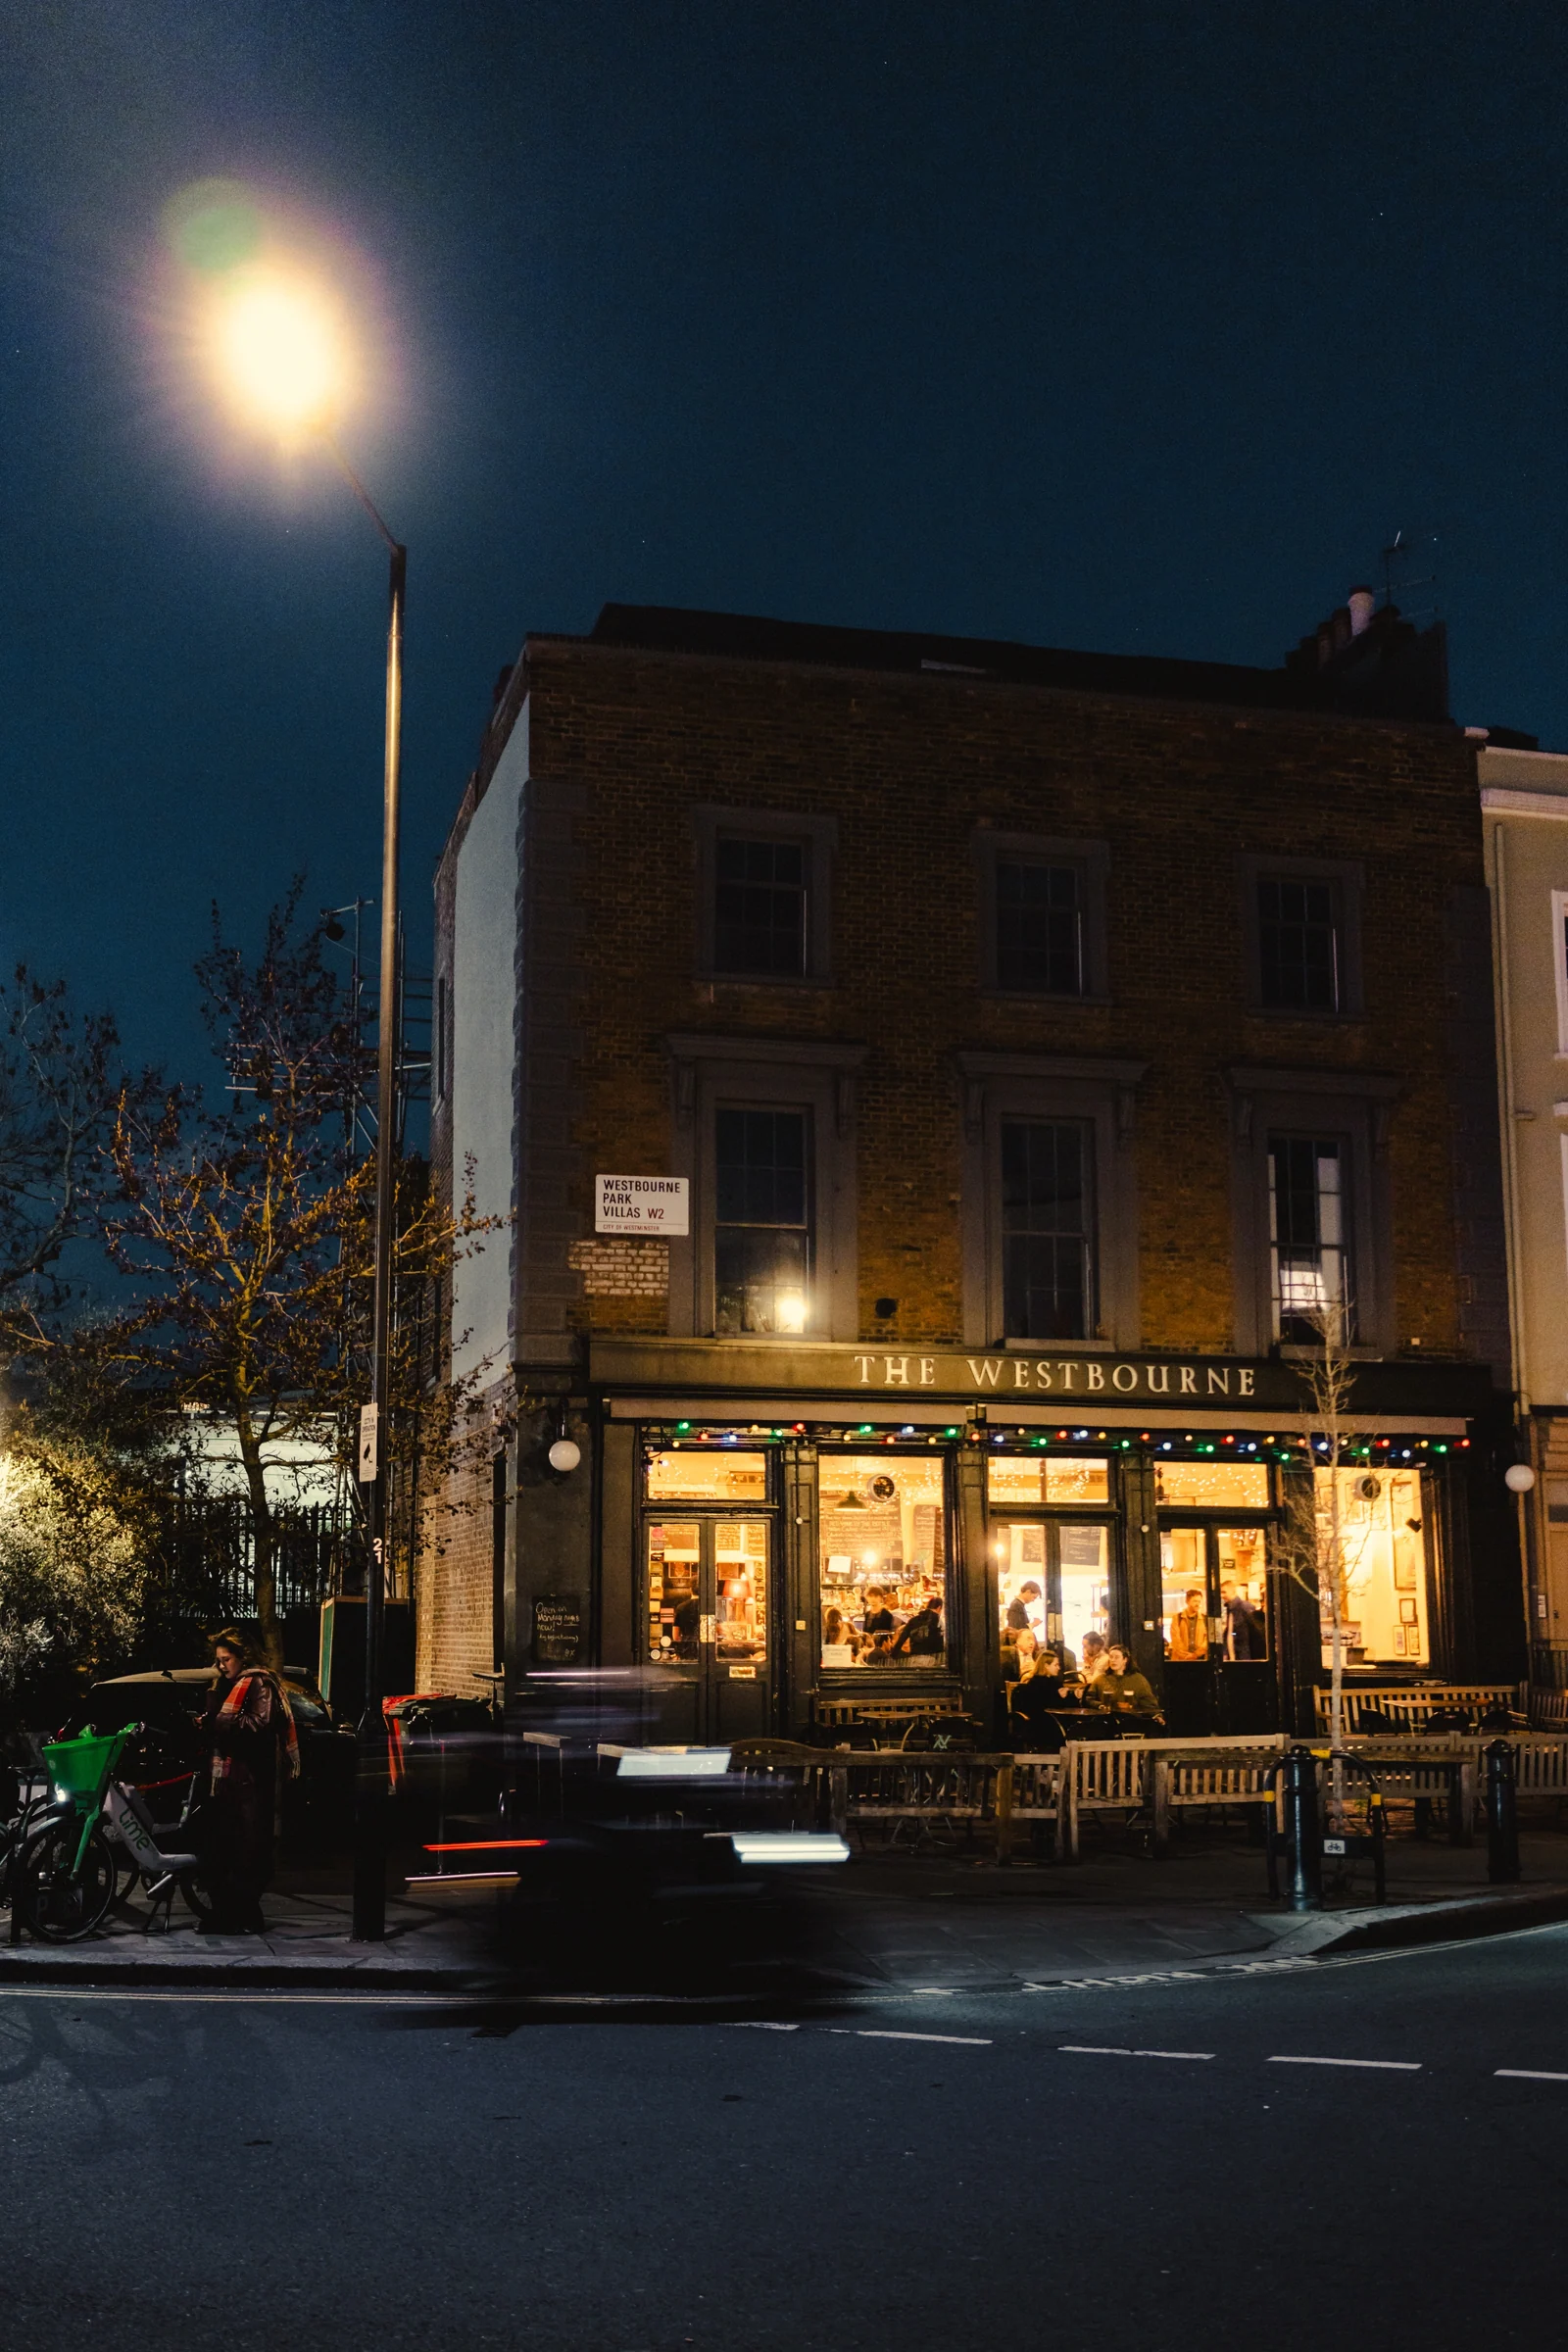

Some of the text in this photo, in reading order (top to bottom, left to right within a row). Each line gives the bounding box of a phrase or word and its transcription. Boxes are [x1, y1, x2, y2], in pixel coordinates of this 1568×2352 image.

[603, 1179, 681, 1194] WESTBOURNE
[603, 1193, 632, 1204] PARK
[603, 1205, 664, 1219] VILLAS W2
[855, 1355, 1256, 1396] THE WESTBOURNE
[536, 1602, 556, 1614] Open
[538, 1614, 563, 1626] Monday
